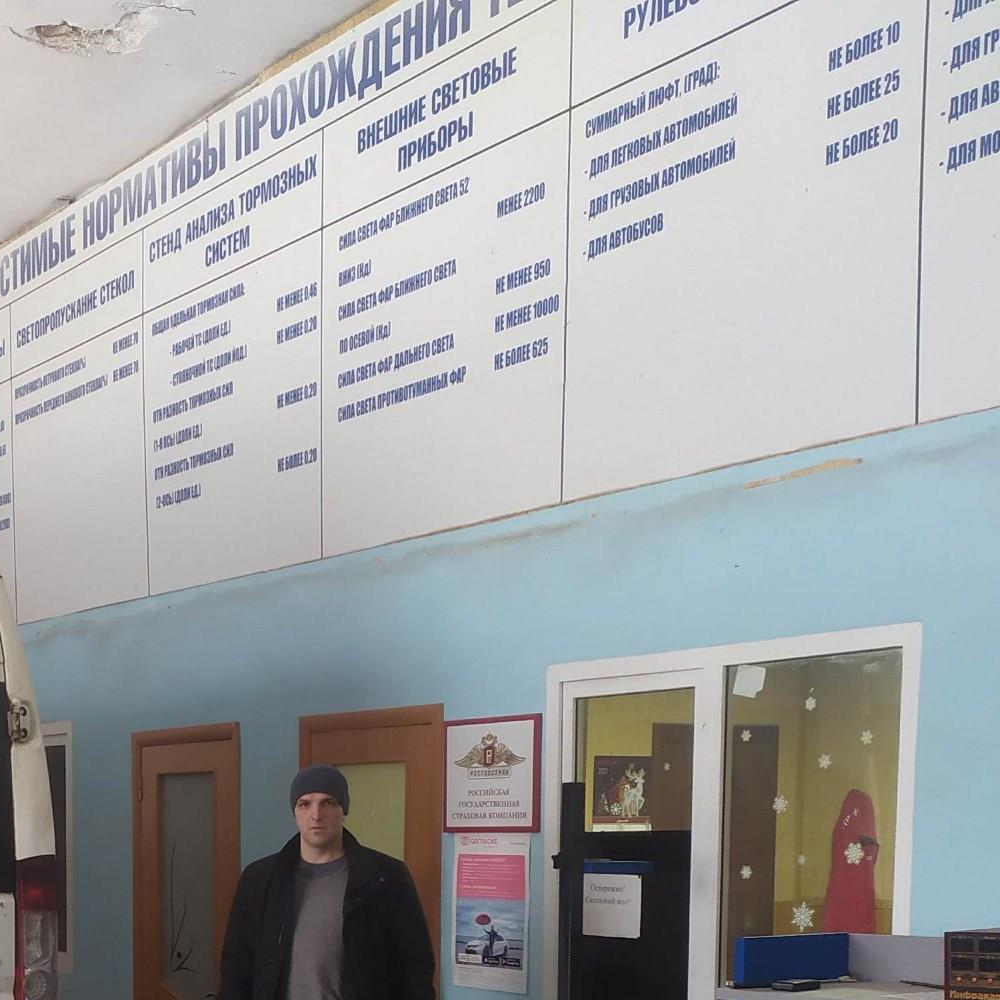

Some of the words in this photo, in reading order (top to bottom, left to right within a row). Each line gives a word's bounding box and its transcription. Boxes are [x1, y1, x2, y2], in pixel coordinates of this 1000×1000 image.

[828, 47, 843, 72] НЕ
[845, 28, 883, 64] БОЛЕЕ
[887, 20, 900, 46] 10
[950, 36, 980, 74] ДЛЯ
[357, 95, 427, 154] ВНЕШНИЕ
[431, 46, 518, 115] СВЕТОВЫЕ
[585, 92, 646, 139] СУММАРНЫЙ
[827, 94, 841, 120] НЕ
[844, 77, 882, 112] БОЛЕЕ
[884, 69, 900, 96] 25
[948, 87, 979, 124] ДЛЯ
[82, 119, 226, 250] НОРМАТИВЫ
[235, 0, 470, 161] ПРОХОЖДЕНИЯ
[397, 111, 474, 172] ПРИБОРЫ
[589, 152, 609, 180] ДЛЯ
[611, 129, 661, 168] ЛЕГКОВЫХ
[663, 92, 738, 145] АВТОМОБИЛЕЙ
[826, 141, 840, 166] НЕ
[842, 126, 880, 160] БОЛЕЕ
[882, 118, 899, 144] 20
[946, 138, 977, 174] ДЛЯ
[496, 192, 522, 219] МЕНЕЕ
[523, 182, 546, 208] 2200
[588, 194, 608, 221] ДЛЯ
[610, 172, 660, 210] ГРУЗОВЫХ
[661, 136, 736, 188] АВТОМОБИЛЕЙ
[149, 227, 182, 264] СТЕНД
[185, 199, 235, 245] АНАЛИЗА
[239, 153, 318, 216] ТОРМОЗНЫХ
[338, 229, 356, 252] СИЛА
[357, 221, 378, 243] СВЕТА
[379, 212, 395, 232] ФАР
[395, 197, 434, 224] БЛИЖНЕГО
[435, 184, 458, 208] СВЕТА
[205, 224, 250, 268] СИСТЕМ
[588, 235, 607, 261] ДЛЯ
[609, 212, 664, 250] АВТОБУСОВ
[338, 265, 356, 287] ВНИЗ
[338, 303, 356, 322] СИЛА
[357, 292, 377, 314] СВЕТА
[378, 284, 393, 304] ФАР
[394, 271, 433, 298] БЛИЖНЕГО
[434, 259, 457, 282] СВЕТА
[495, 276, 505, 296] НЕ
[507, 266, 533, 291] МЕНЕЕ
[534, 258, 551, 281] 950
[16, 289, 98, 348] СВЕТОПРОПУСКАНИЕ
[100, 270, 135, 305] СТЕКОЛ
[276, 295, 285, 312] НЕ
[285, 288, 303, 309] МЕНЕЕ
[494, 314, 505, 334] НЕ
[506, 304, 532, 329] МЕНЕЕ
[533, 294, 560, 318] 10000
[276, 329, 285, 345] НЕ
[285, 321, 303, 341] МЕНЕЕ
[339, 337, 348, 355] ПО
[349, 324, 375, 351] ОСЕВОЙ
[494, 353, 504, 371] НЕ
[505, 343, 531, 367] БОЛЕЕ
[532, 337, 549, 359] 625
[338, 370, 355, 389] СИЛА
[356, 360, 376, 382] СВЕТА
[377, 354, 393, 374] ФАР
[394, 342, 430, 372] ДАЛЬНЕГО
[431, 333, 455, 356] СВЕТА
[276, 393, 285, 409] НЕ
[285, 386, 303, 407] МЕНЕЕ
[337, 404, 355, 422] СИЛА
[356, 396, 376, 416] СВЕТА
[377, 374, 449, 410] ПРОТИВОТУМАННЫХ
[450, 365, 467, 386] ФАР
[277, 457, 285, 473] НЕ
[285, 451, 304, 471] БОЛЕЕ
[458, 800, 520, 809] ГОСУДАРСТВЕННАЯ
[468, 787, 510, 797] РОССИЙСКАЯ
[452, 812, 487, 820] СТРАХОВАЯ
[488, 811, 527, 819] КОМПАНИЯ
